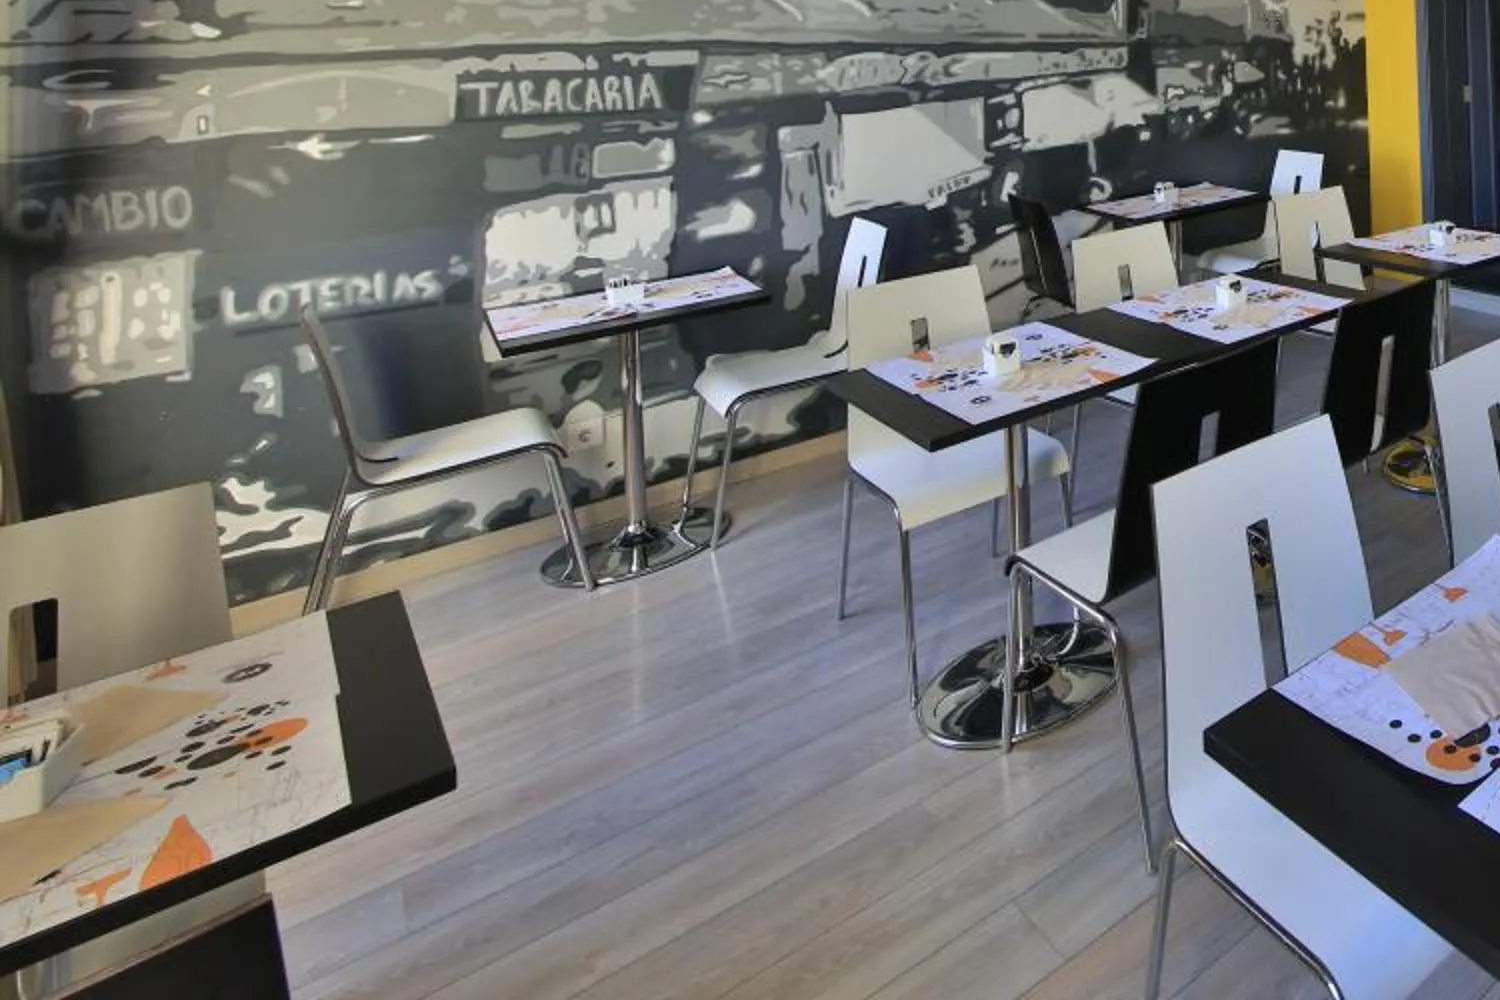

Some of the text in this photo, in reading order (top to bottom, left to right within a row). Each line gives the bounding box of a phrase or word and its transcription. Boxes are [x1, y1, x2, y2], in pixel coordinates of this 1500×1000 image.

[459, 72, 663, 116] TABACARIA
[10, 185, 193, 236] CAMBIO
[220, 269, 443, 324] LOTERIAS
